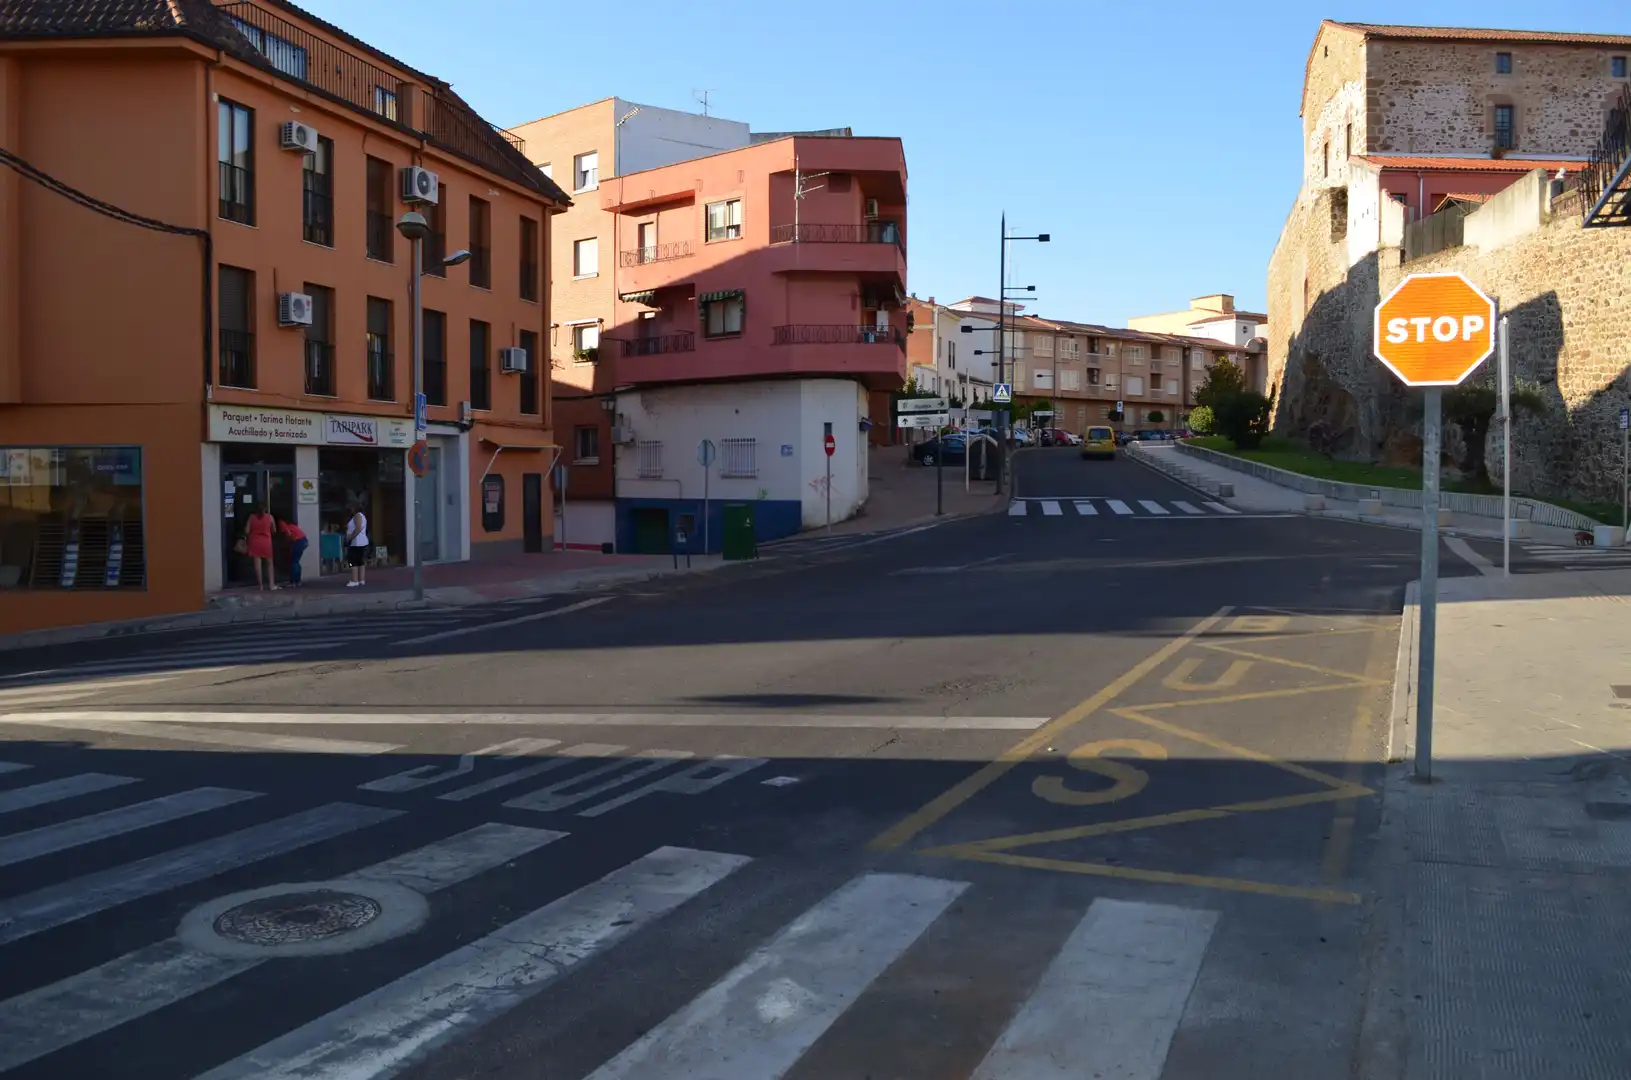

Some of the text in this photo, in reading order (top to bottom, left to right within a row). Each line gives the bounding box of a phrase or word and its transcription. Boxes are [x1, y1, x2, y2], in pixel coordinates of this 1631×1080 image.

[1385, 315, 1485, 344] STOP
[222, 411, 253, 425] Parquet
[259, 413, 284, 424] Tarima
[228, 426, 308, 440] Acuchillado y Barnizado
[330, 419, 373, 435] TARIPARK
[357, 737, 770, 818] STOP
